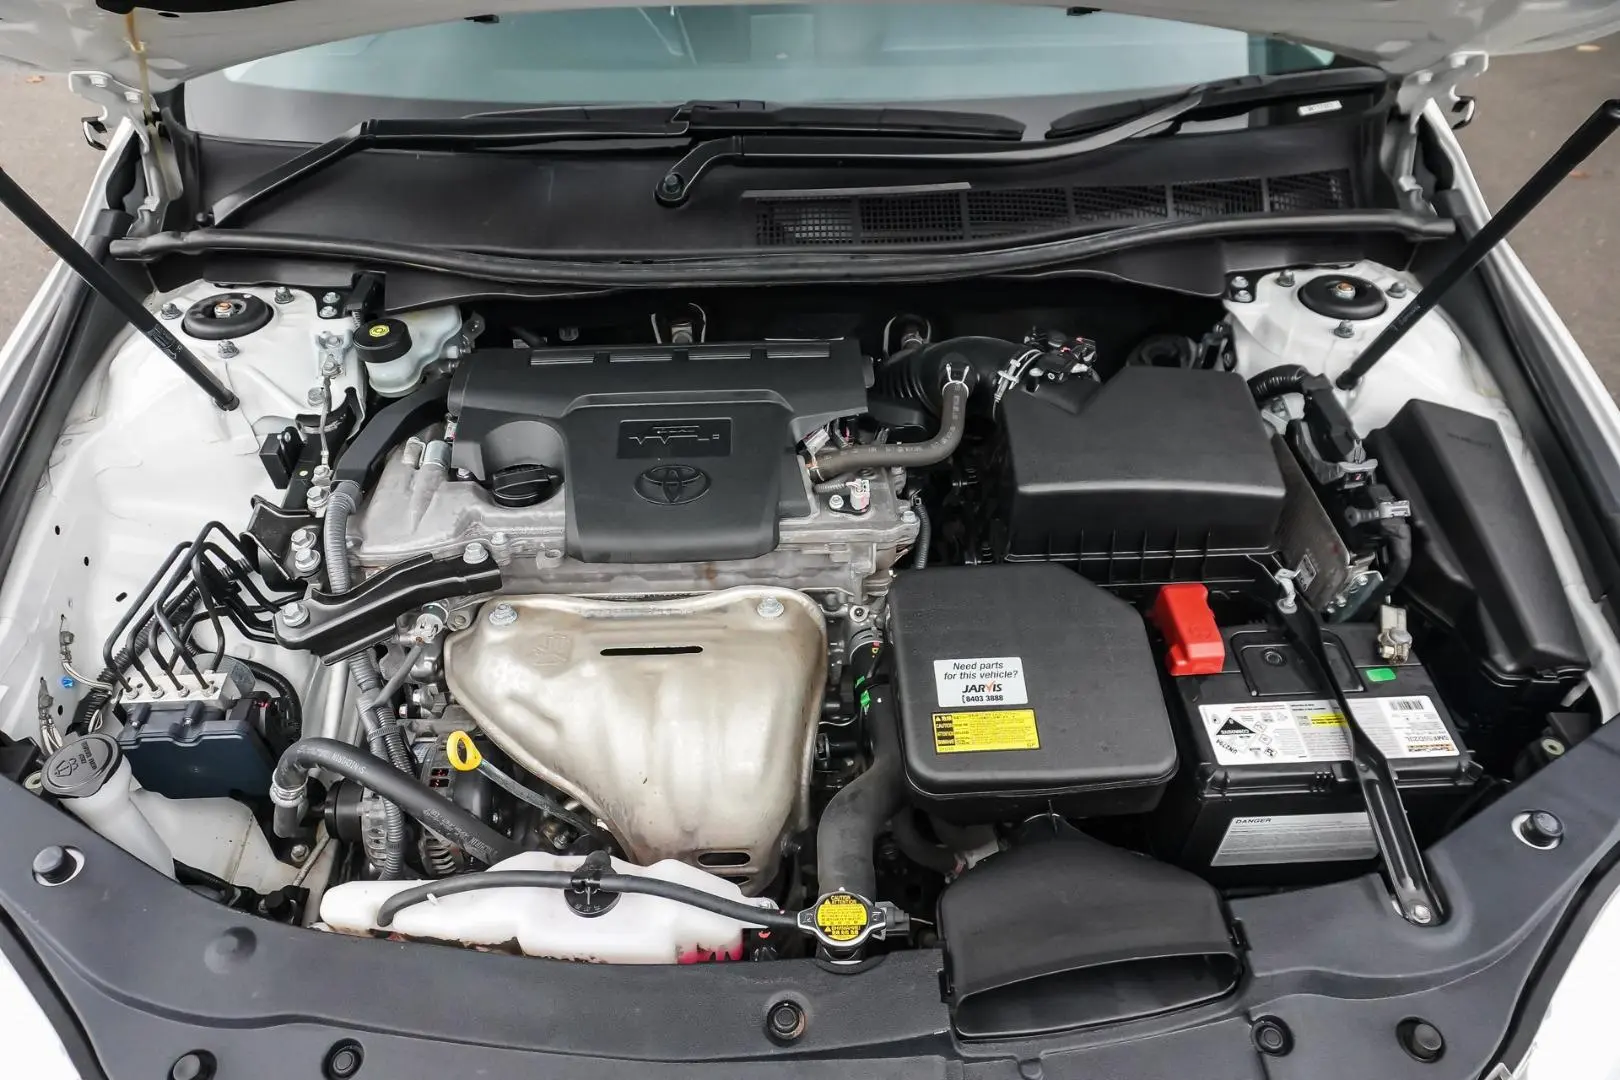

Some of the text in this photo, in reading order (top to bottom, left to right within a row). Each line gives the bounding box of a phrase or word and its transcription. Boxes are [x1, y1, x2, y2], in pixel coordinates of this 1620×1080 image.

[953, 661, 1004, 670] Need parts
[944, 670, 1018, 680] for this vehicle?
